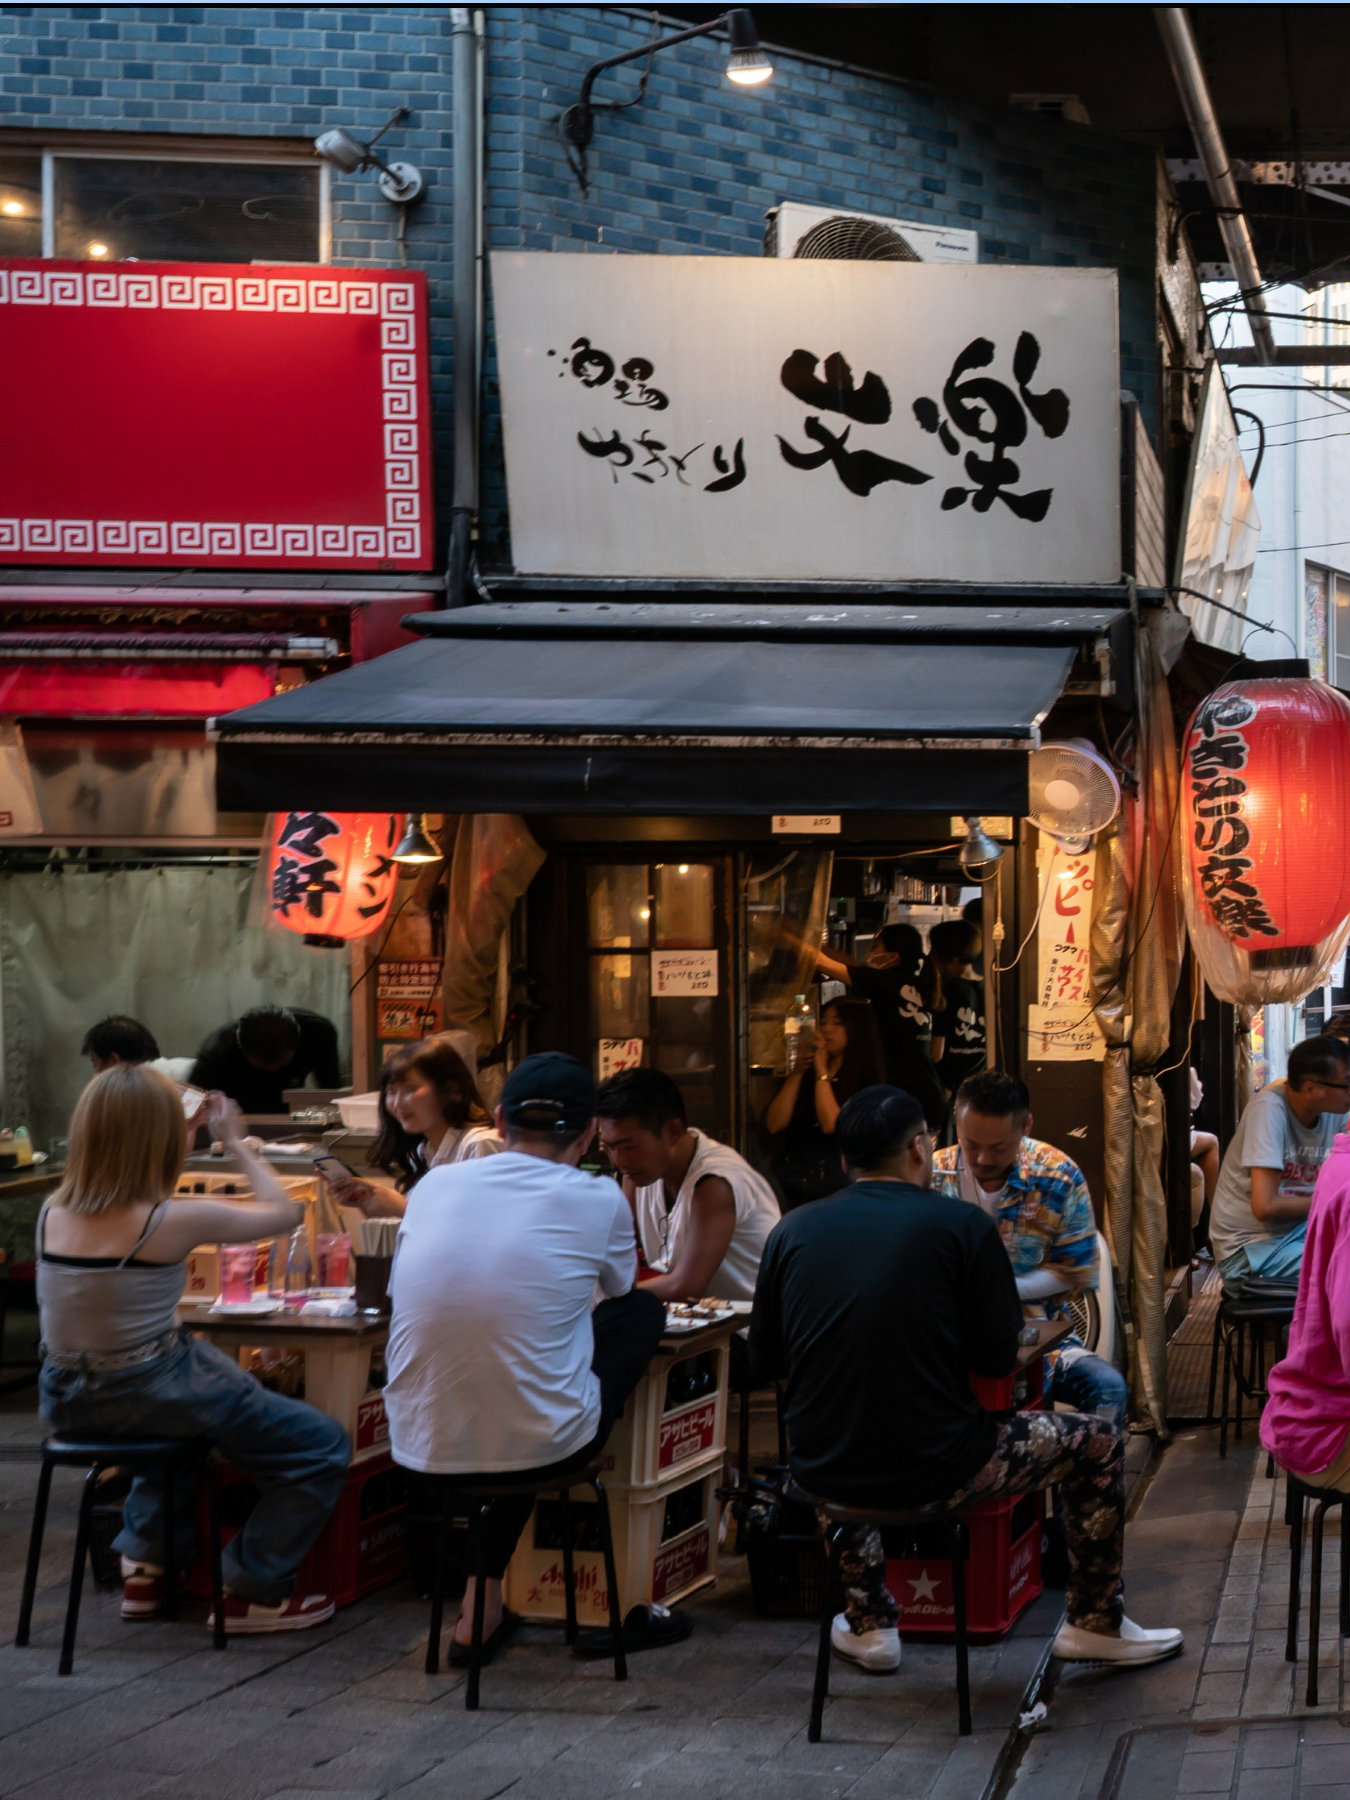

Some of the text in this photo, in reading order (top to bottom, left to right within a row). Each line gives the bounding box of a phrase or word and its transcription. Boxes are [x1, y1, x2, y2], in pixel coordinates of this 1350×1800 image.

[935, 241, 969, 251] Panasonic
[547, 336, 670, 411] 酒場
[775, 330, 1070, 523] 文楽
[577, 426, 747, 493] やきとり
[1053, 846, 1094, 945] ッピー
[660, 1407, 714, 1448] アサヒビール
[655, 1535, 708, 1581] アサヒビール
[902, 1603, 955, 1615] ッポロビール
